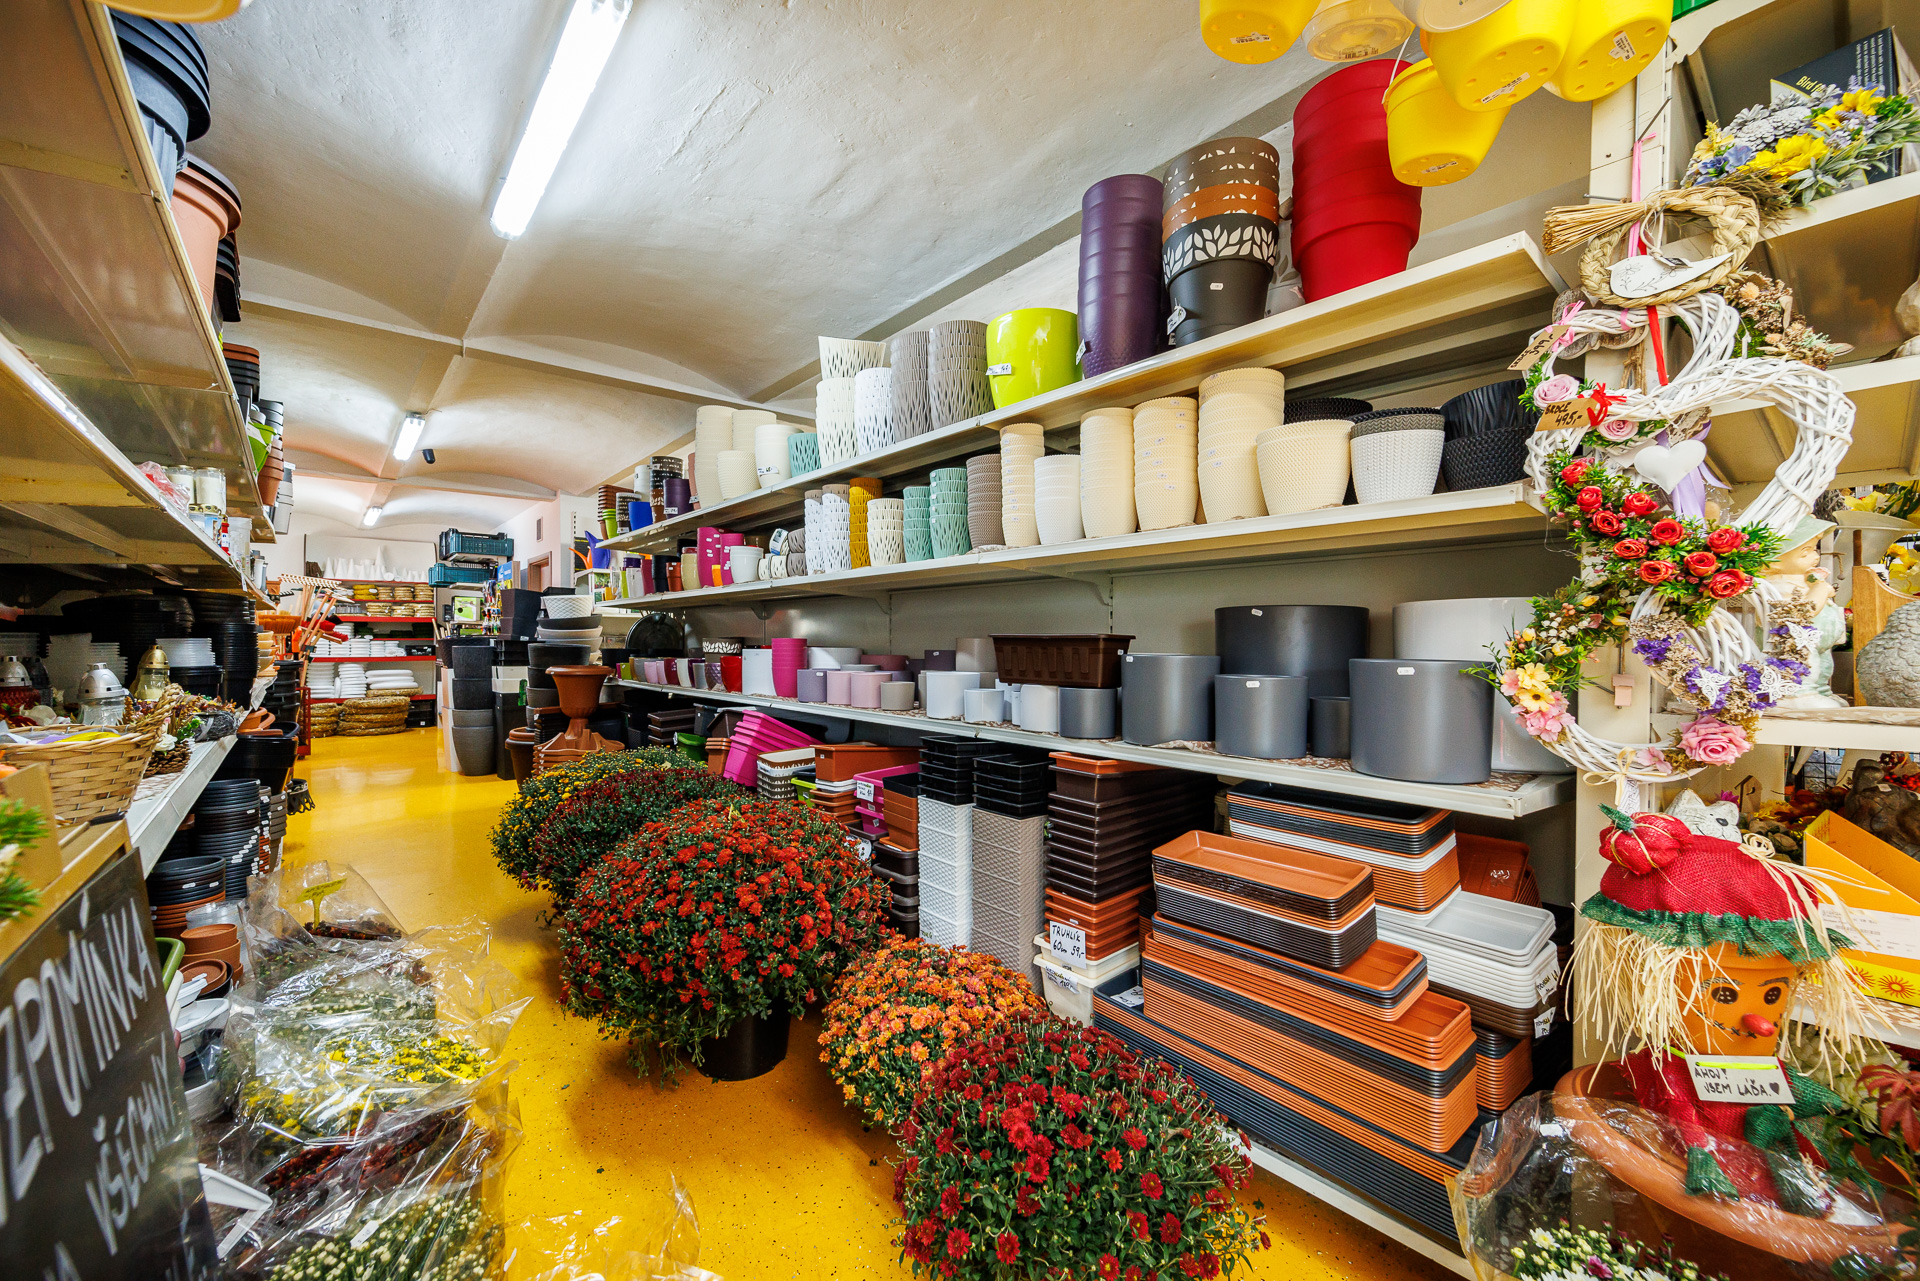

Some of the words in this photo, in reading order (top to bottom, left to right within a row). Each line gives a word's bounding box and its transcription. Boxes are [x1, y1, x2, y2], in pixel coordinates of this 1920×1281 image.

[1796, 75, 1817, 90] Bird
[1052, 924, 1081, 942] TRUHLÍK
[1071, 945, 1085, 958] 59,-
[1694, 1067, 1728, 1080] AHOJ!
[1704, 1081, 1732, 1094] JSEM
[86, 1030, 176, 1256] VŠECHNY
